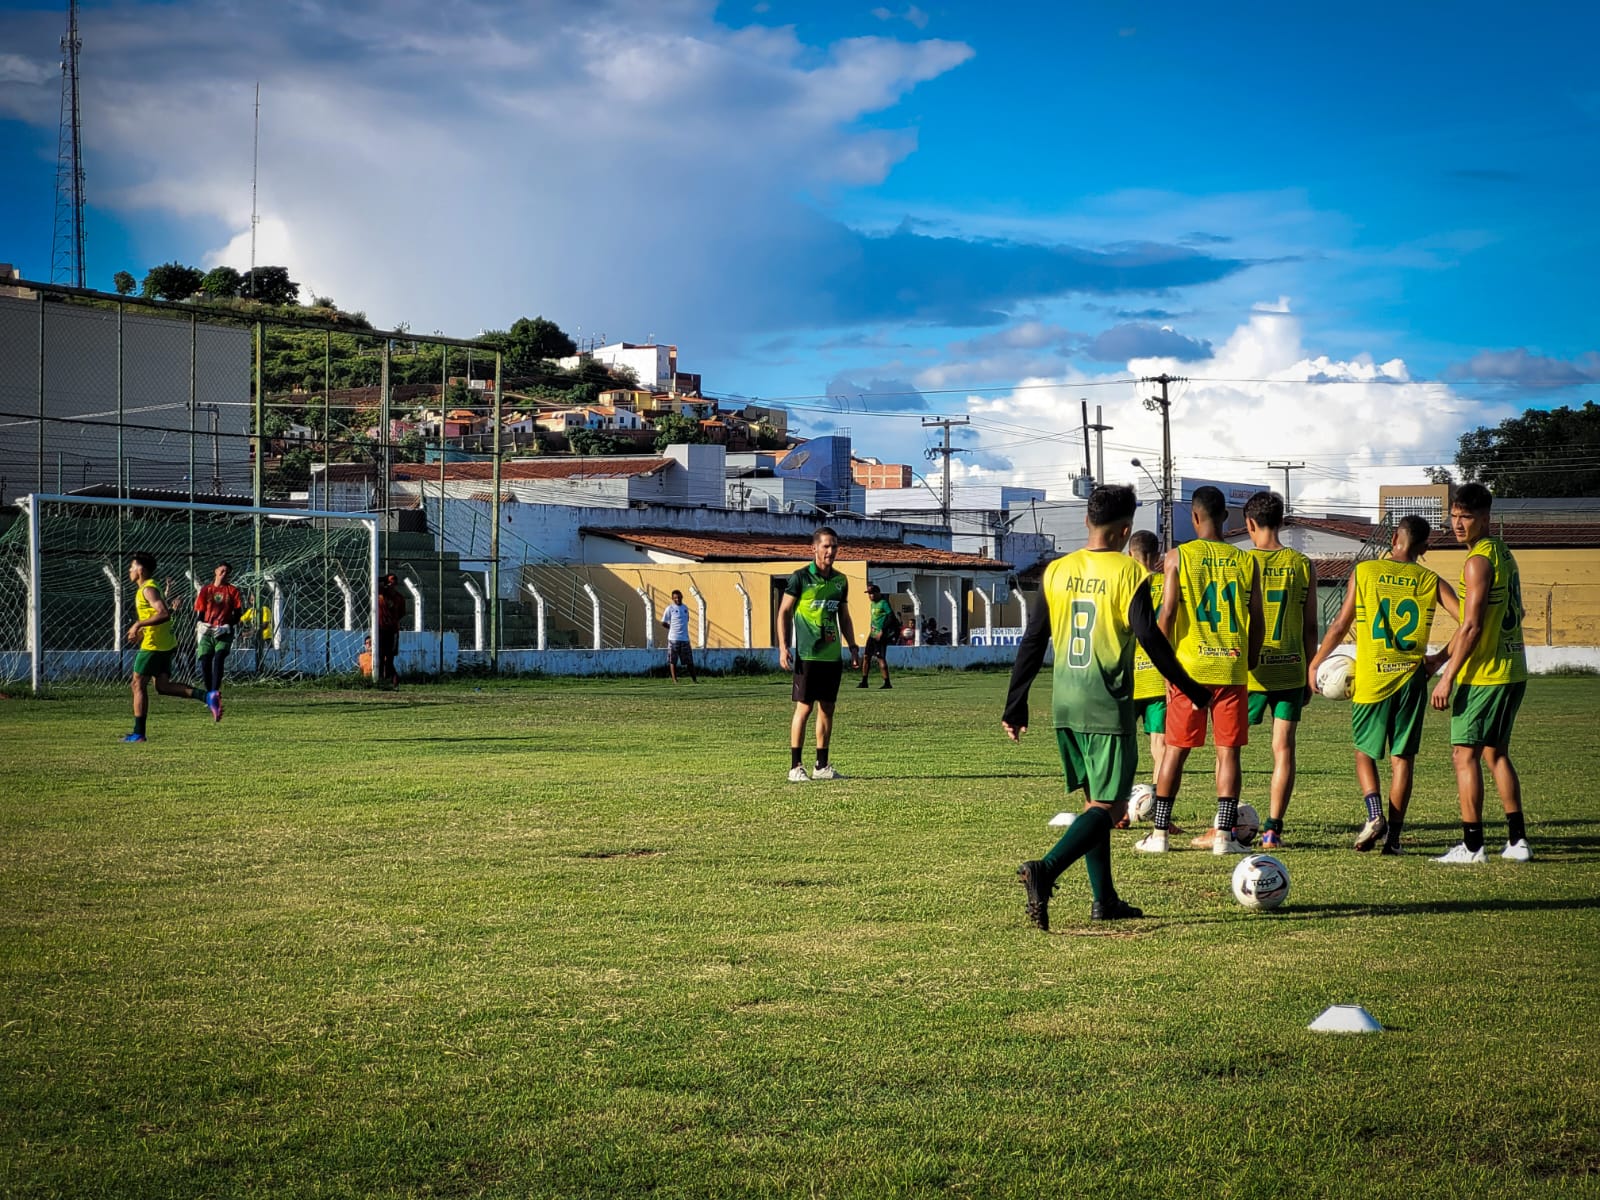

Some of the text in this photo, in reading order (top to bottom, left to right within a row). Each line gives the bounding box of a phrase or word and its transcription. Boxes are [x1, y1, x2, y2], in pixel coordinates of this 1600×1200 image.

[1201, 557, 1237, 567] ATLETA
[1262, 567, 1296, 577] ATLETA
[1066, 575, 1106, 595] ATLETA
[1378, 574, 1418, 587] ATLETA
[1196, 580, 1238, 633] 41
[1266, 589, 1288, 641] 7
[1372, 597, 1419, 652] 42
[1067, 599, 1097, 669] 8
